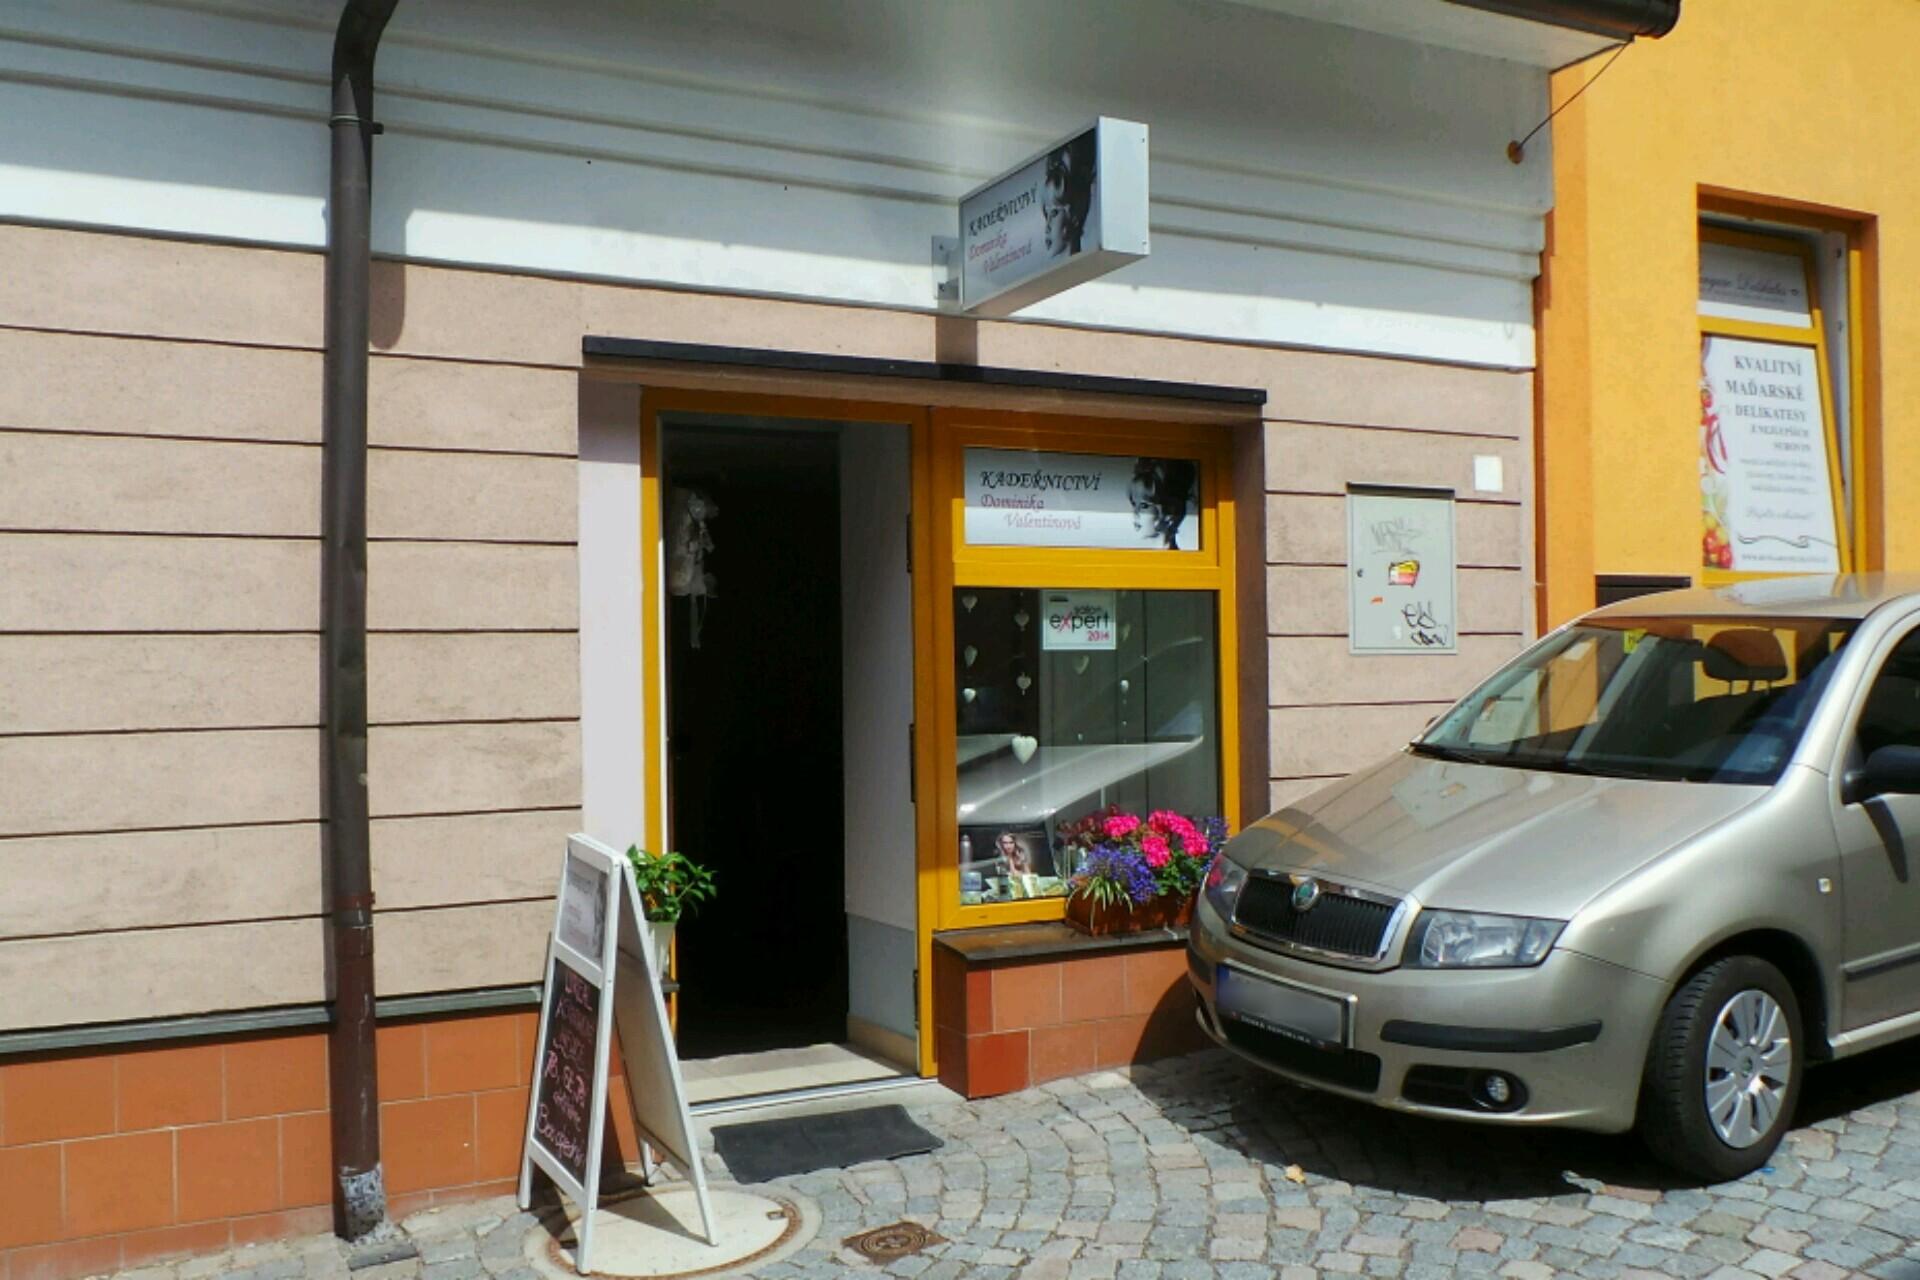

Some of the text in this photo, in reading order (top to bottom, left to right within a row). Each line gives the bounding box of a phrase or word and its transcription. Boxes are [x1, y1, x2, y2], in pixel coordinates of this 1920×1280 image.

[1733, 355, 1802, 376] KVALITNÍ
[1725, 378, 1805, 401] MAĎARSKÉ
[1735, 404, 1806, 422] DELIKATESY
[980, 469, 1102, 492] KADEŘNICTVÍ
[980, 494, 1045, 510] Dominika
[1004, 513, 1082, 531] Valentinová
[1050, 609, 1110, 634] expert
[1087, 630, 1110, 642] 2014
